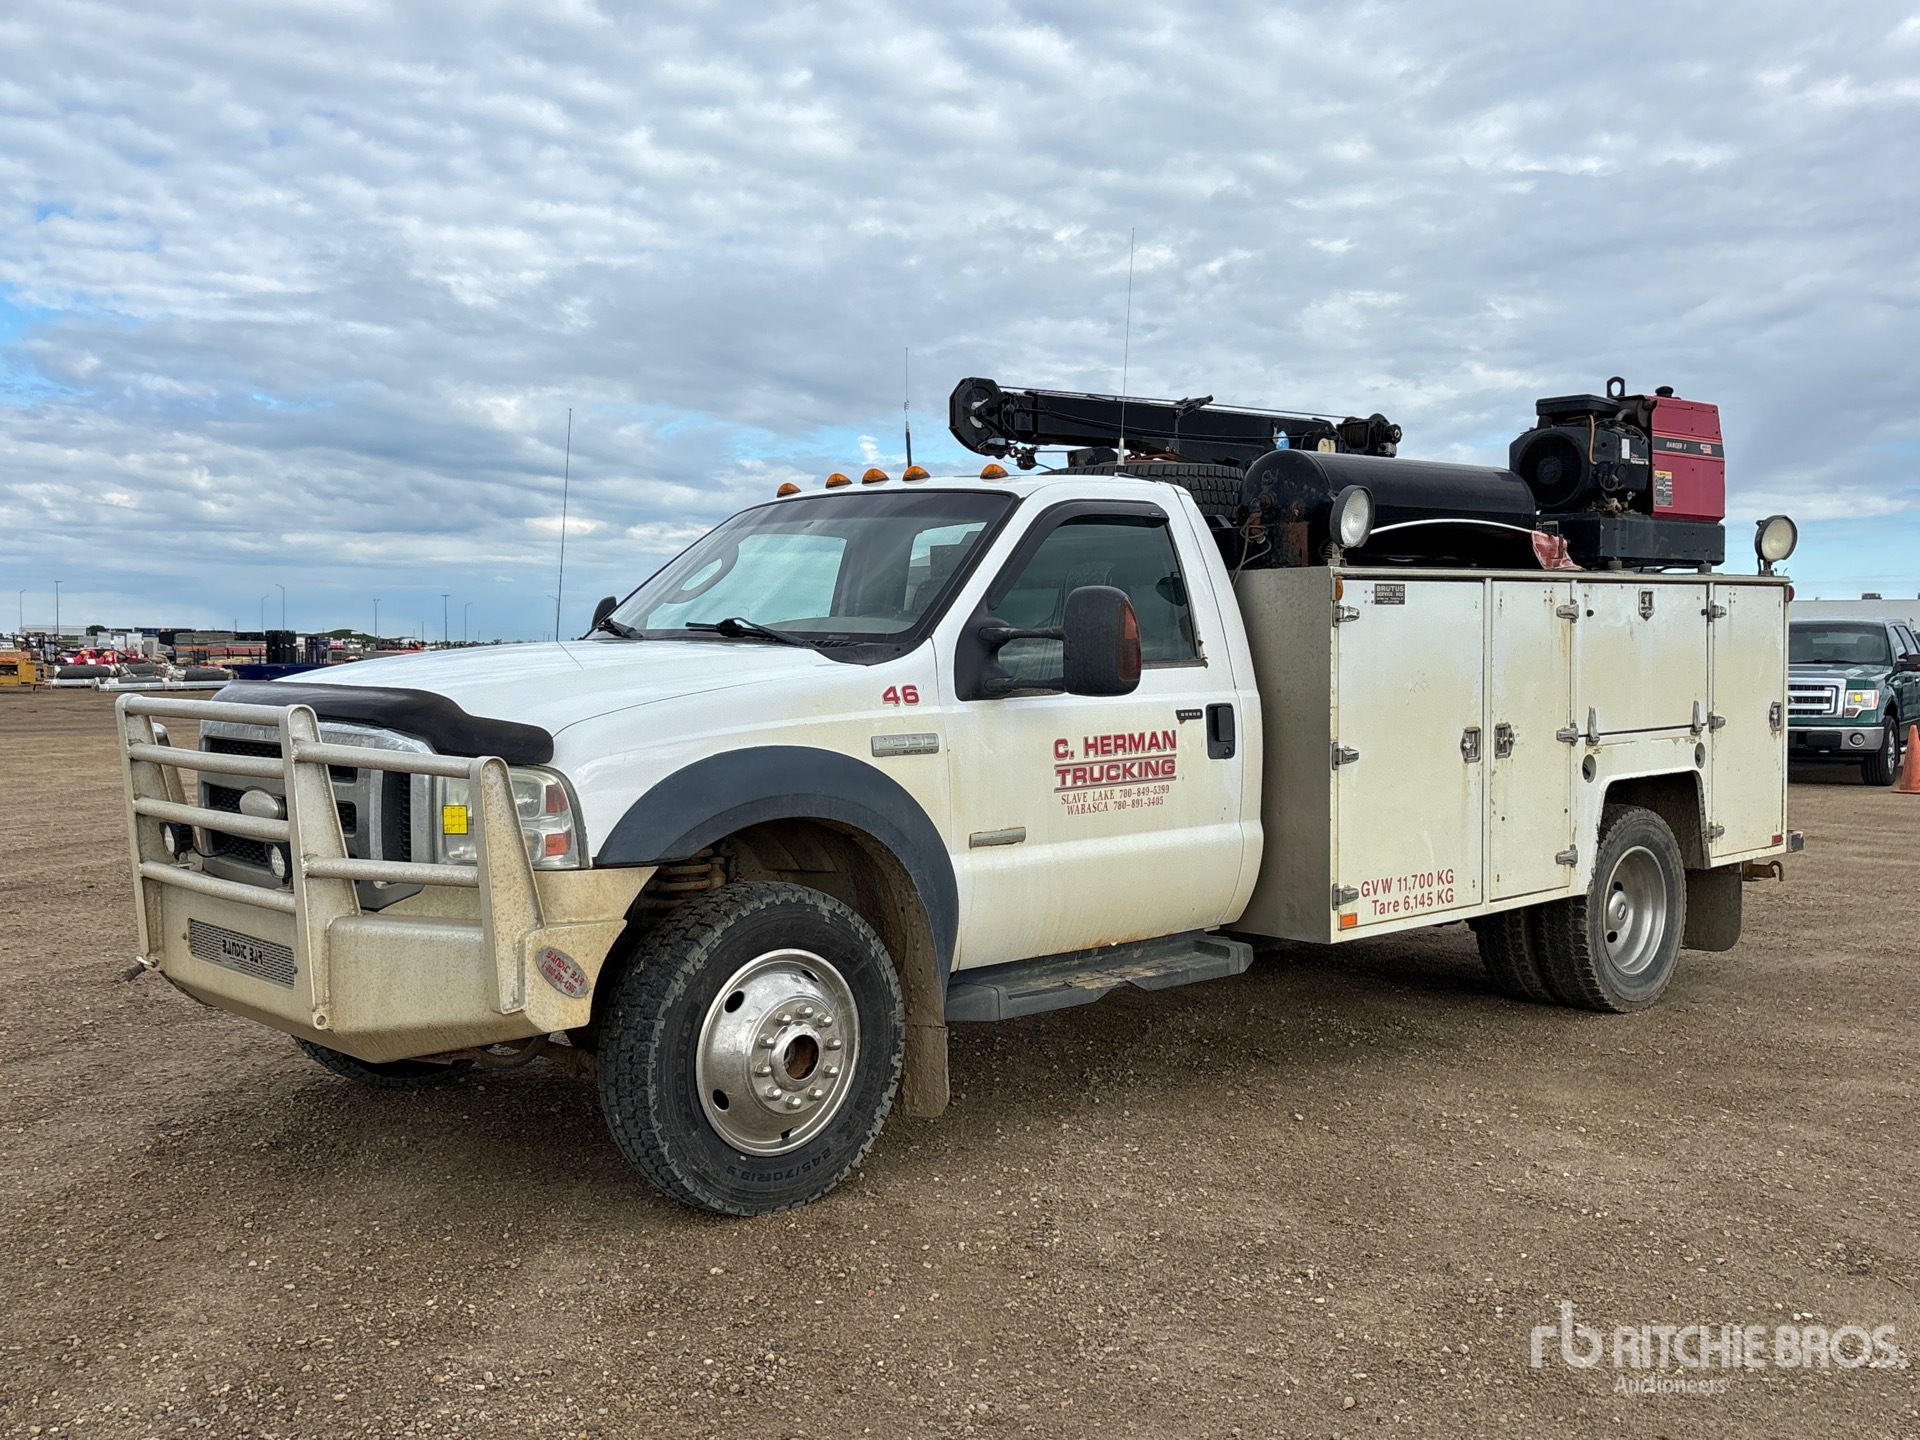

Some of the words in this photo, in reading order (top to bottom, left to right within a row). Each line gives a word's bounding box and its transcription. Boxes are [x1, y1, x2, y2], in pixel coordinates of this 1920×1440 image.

[881, 684, 920, 707] 46
[1053, 738, 1075, 760] C.
[1083, 730, 1177, 758] HERMAN
[1056, 759, 1176, 786] TRUCKING
[1061, 791, 1088, 805] SLAVE
[1092, 789, 1115, 801] LAKE
[1119, 784, 1170, 799] 780-849-5399
[1067, 801, 1109, 815] WABASCA
[1113, 796, 1164, 810] 780-891-3405
[1360, 877, 1393, 898] GVW
[1397, 872, 1434, 893] 11,700
[1437, 868, 1454, 886] KG
[1371, 899, 1400, 916] Tare
[1403, 891, 1433, 913] 6,145
[1437, 888, 1454, 905] KG
[249, 947, 264, 965] BAR
[570, 970, 585, 986] BAR
[726, 1147, 832, 1182] 245/70R19.5
